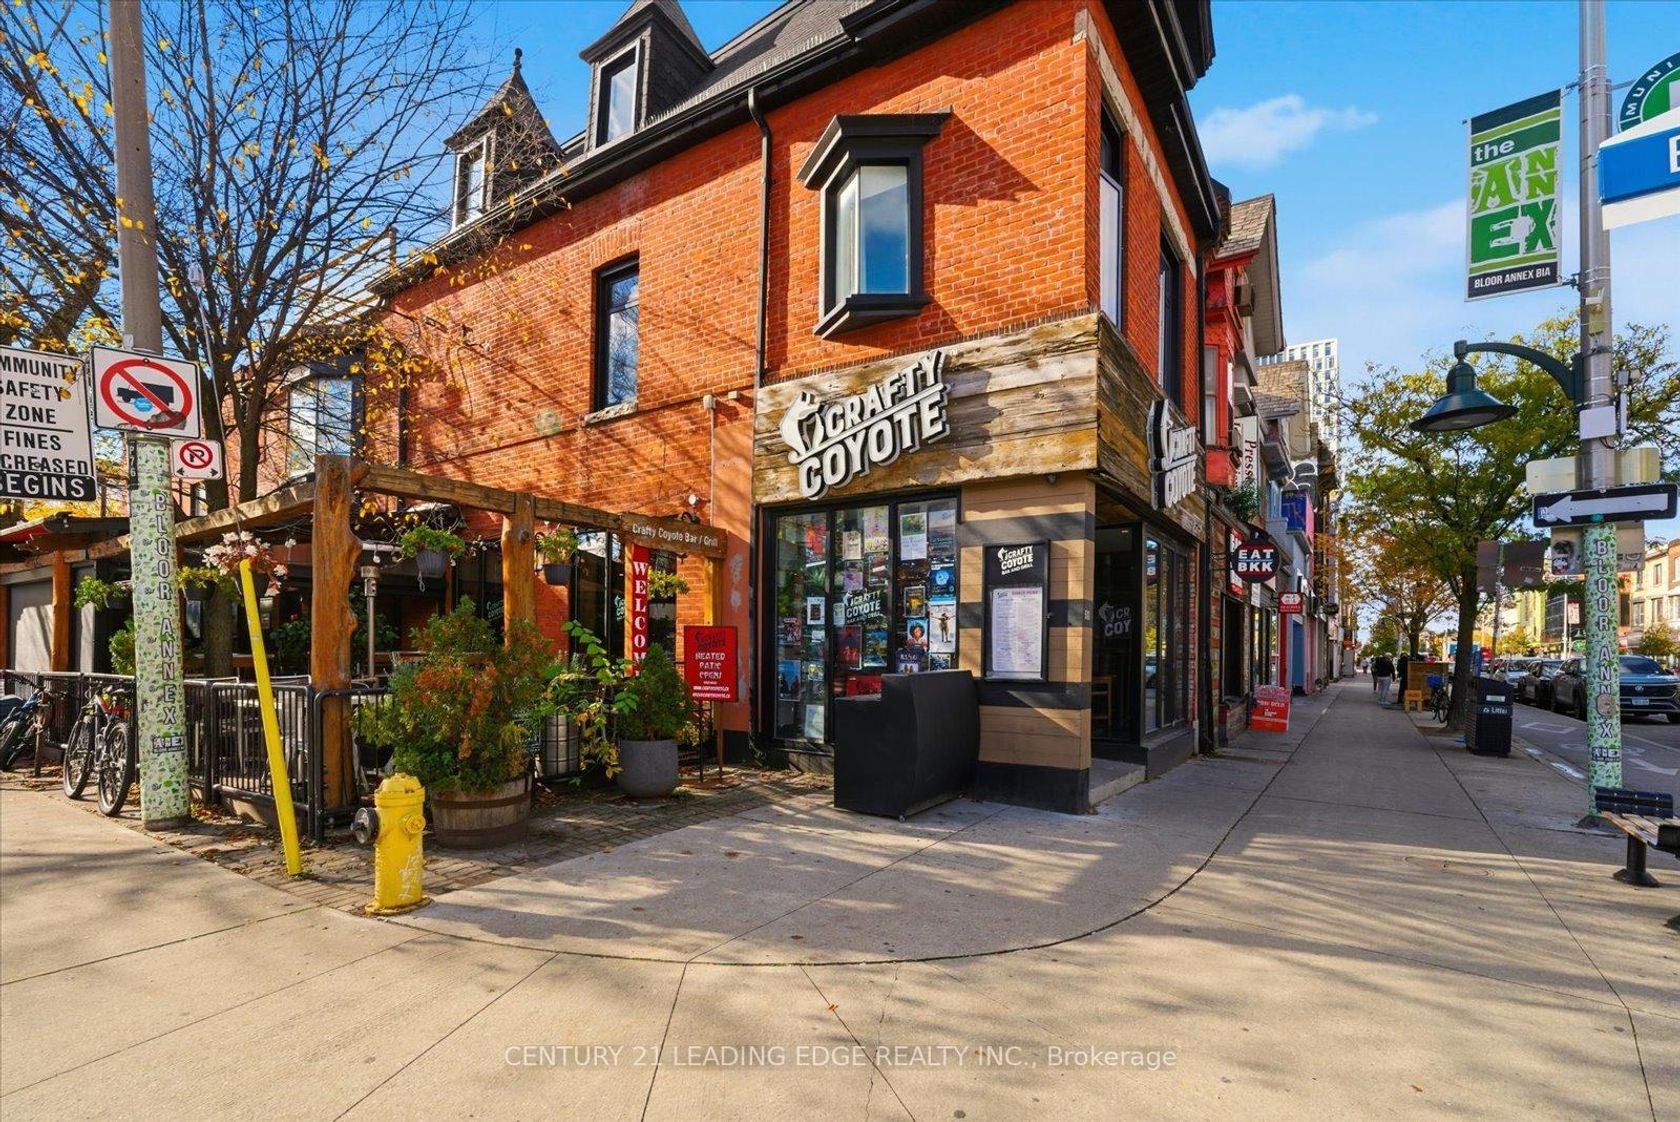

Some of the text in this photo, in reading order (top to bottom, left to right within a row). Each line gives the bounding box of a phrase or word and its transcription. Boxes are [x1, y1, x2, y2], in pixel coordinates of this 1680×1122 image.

[1474, 139, 1515, 162] the
[1474, 266, 1551, 289] BLOOR ANNEX BIA
[824, 350, 944, 438] CRAFTY
[6, 403, 57, 425] ZONE
[4, 430, 62, 451] FINES
[800, 391, 947, 499] COYOTE
[0, 473, 85, 498] EGINS
[632, 523, 657, 538] Crafty
[658, 527, 683, 541] Coyote
[684, 532, 697, 544] Bar
[154, 492, 172, 601] BLOOR
[1008, 545, 1034, 559] CRAFTY
[1238, 548, 1275, 560] EAT
[1001, 553, 1034, 571] COYOTE
[1237, 561, 1274, 573] BKK
[1595, 538, 1610, 631] BLOOR
[846, 599, 881, 618] COYOTE
[695, 652, 726, 661] HEATED
[160, 617, 177, 726] ANNEX
[1599, 645, 1612, 739] ANNX
